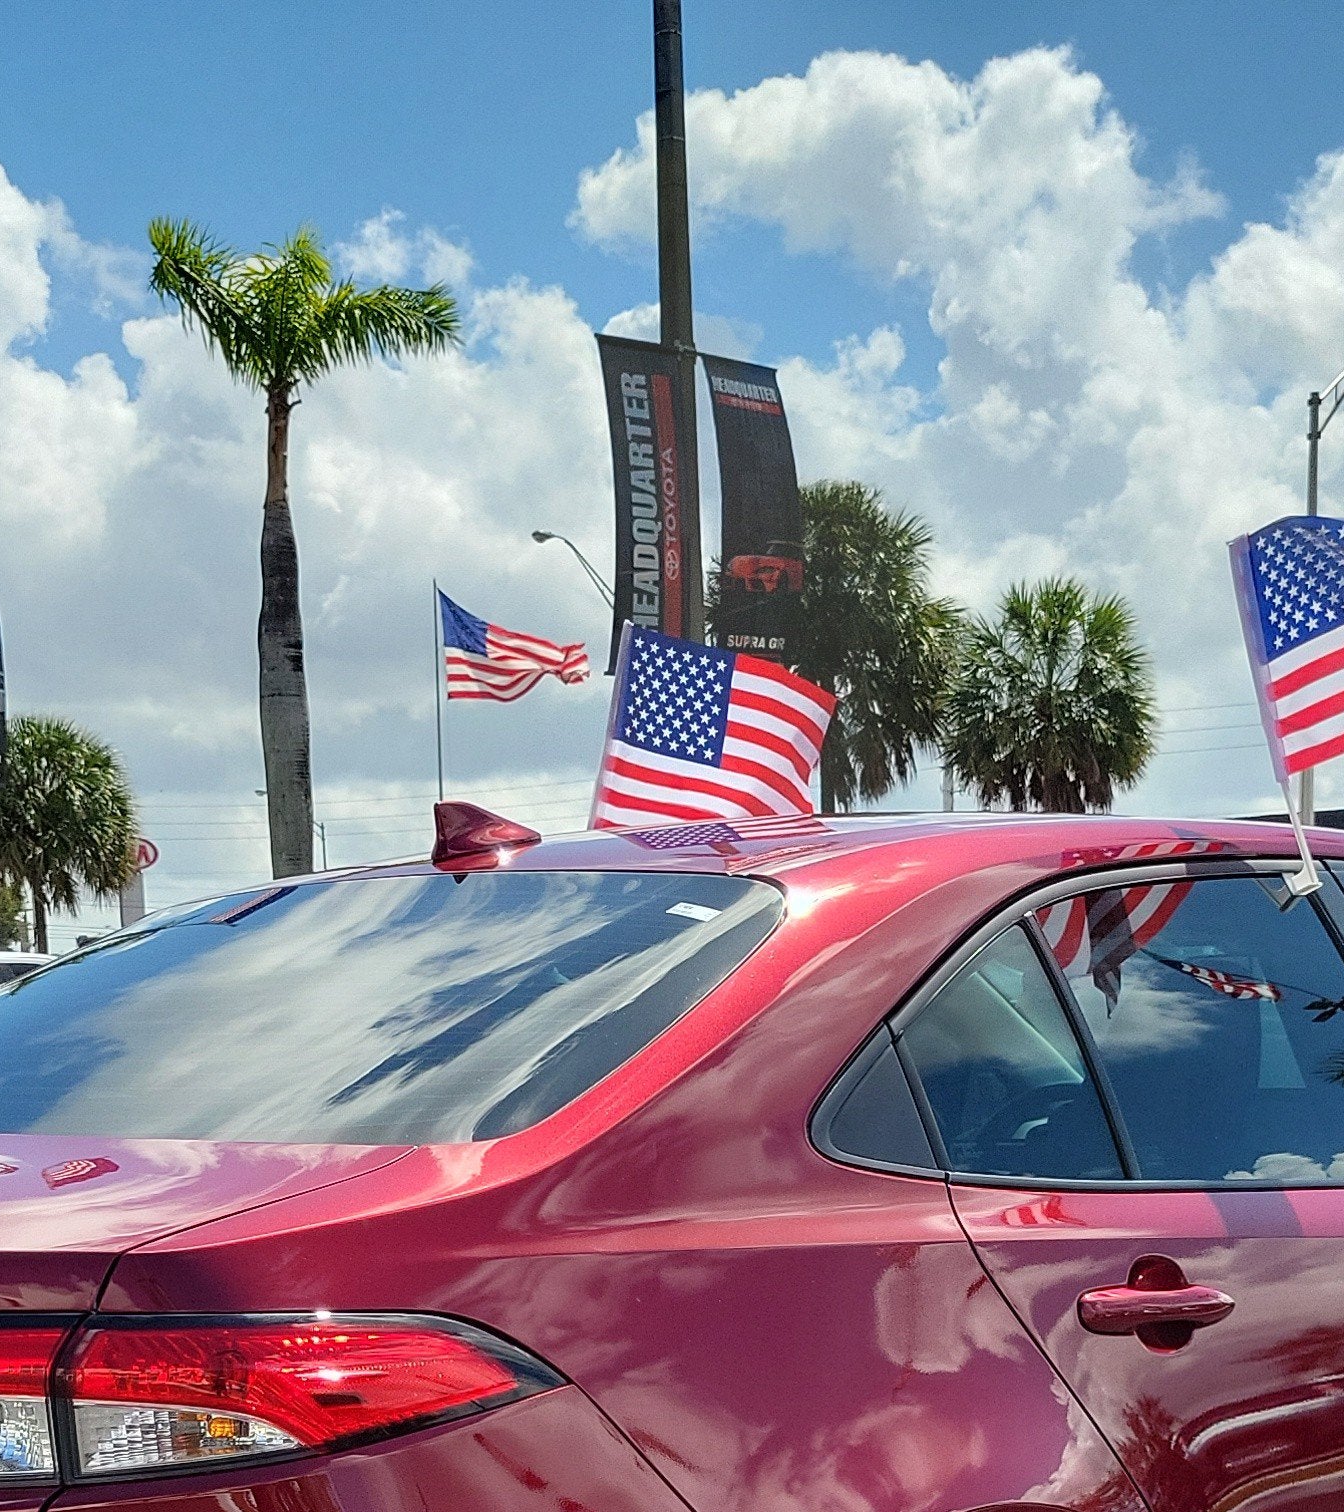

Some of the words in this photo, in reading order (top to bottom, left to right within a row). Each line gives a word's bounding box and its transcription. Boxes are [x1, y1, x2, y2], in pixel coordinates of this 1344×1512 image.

[621, 372, 662, 634] HEADQUARTER
[661, 448, 677, 547] TOYOTA
[727, 634, 766, 649] SUPRA
[768, 637, 786, 651] GR
